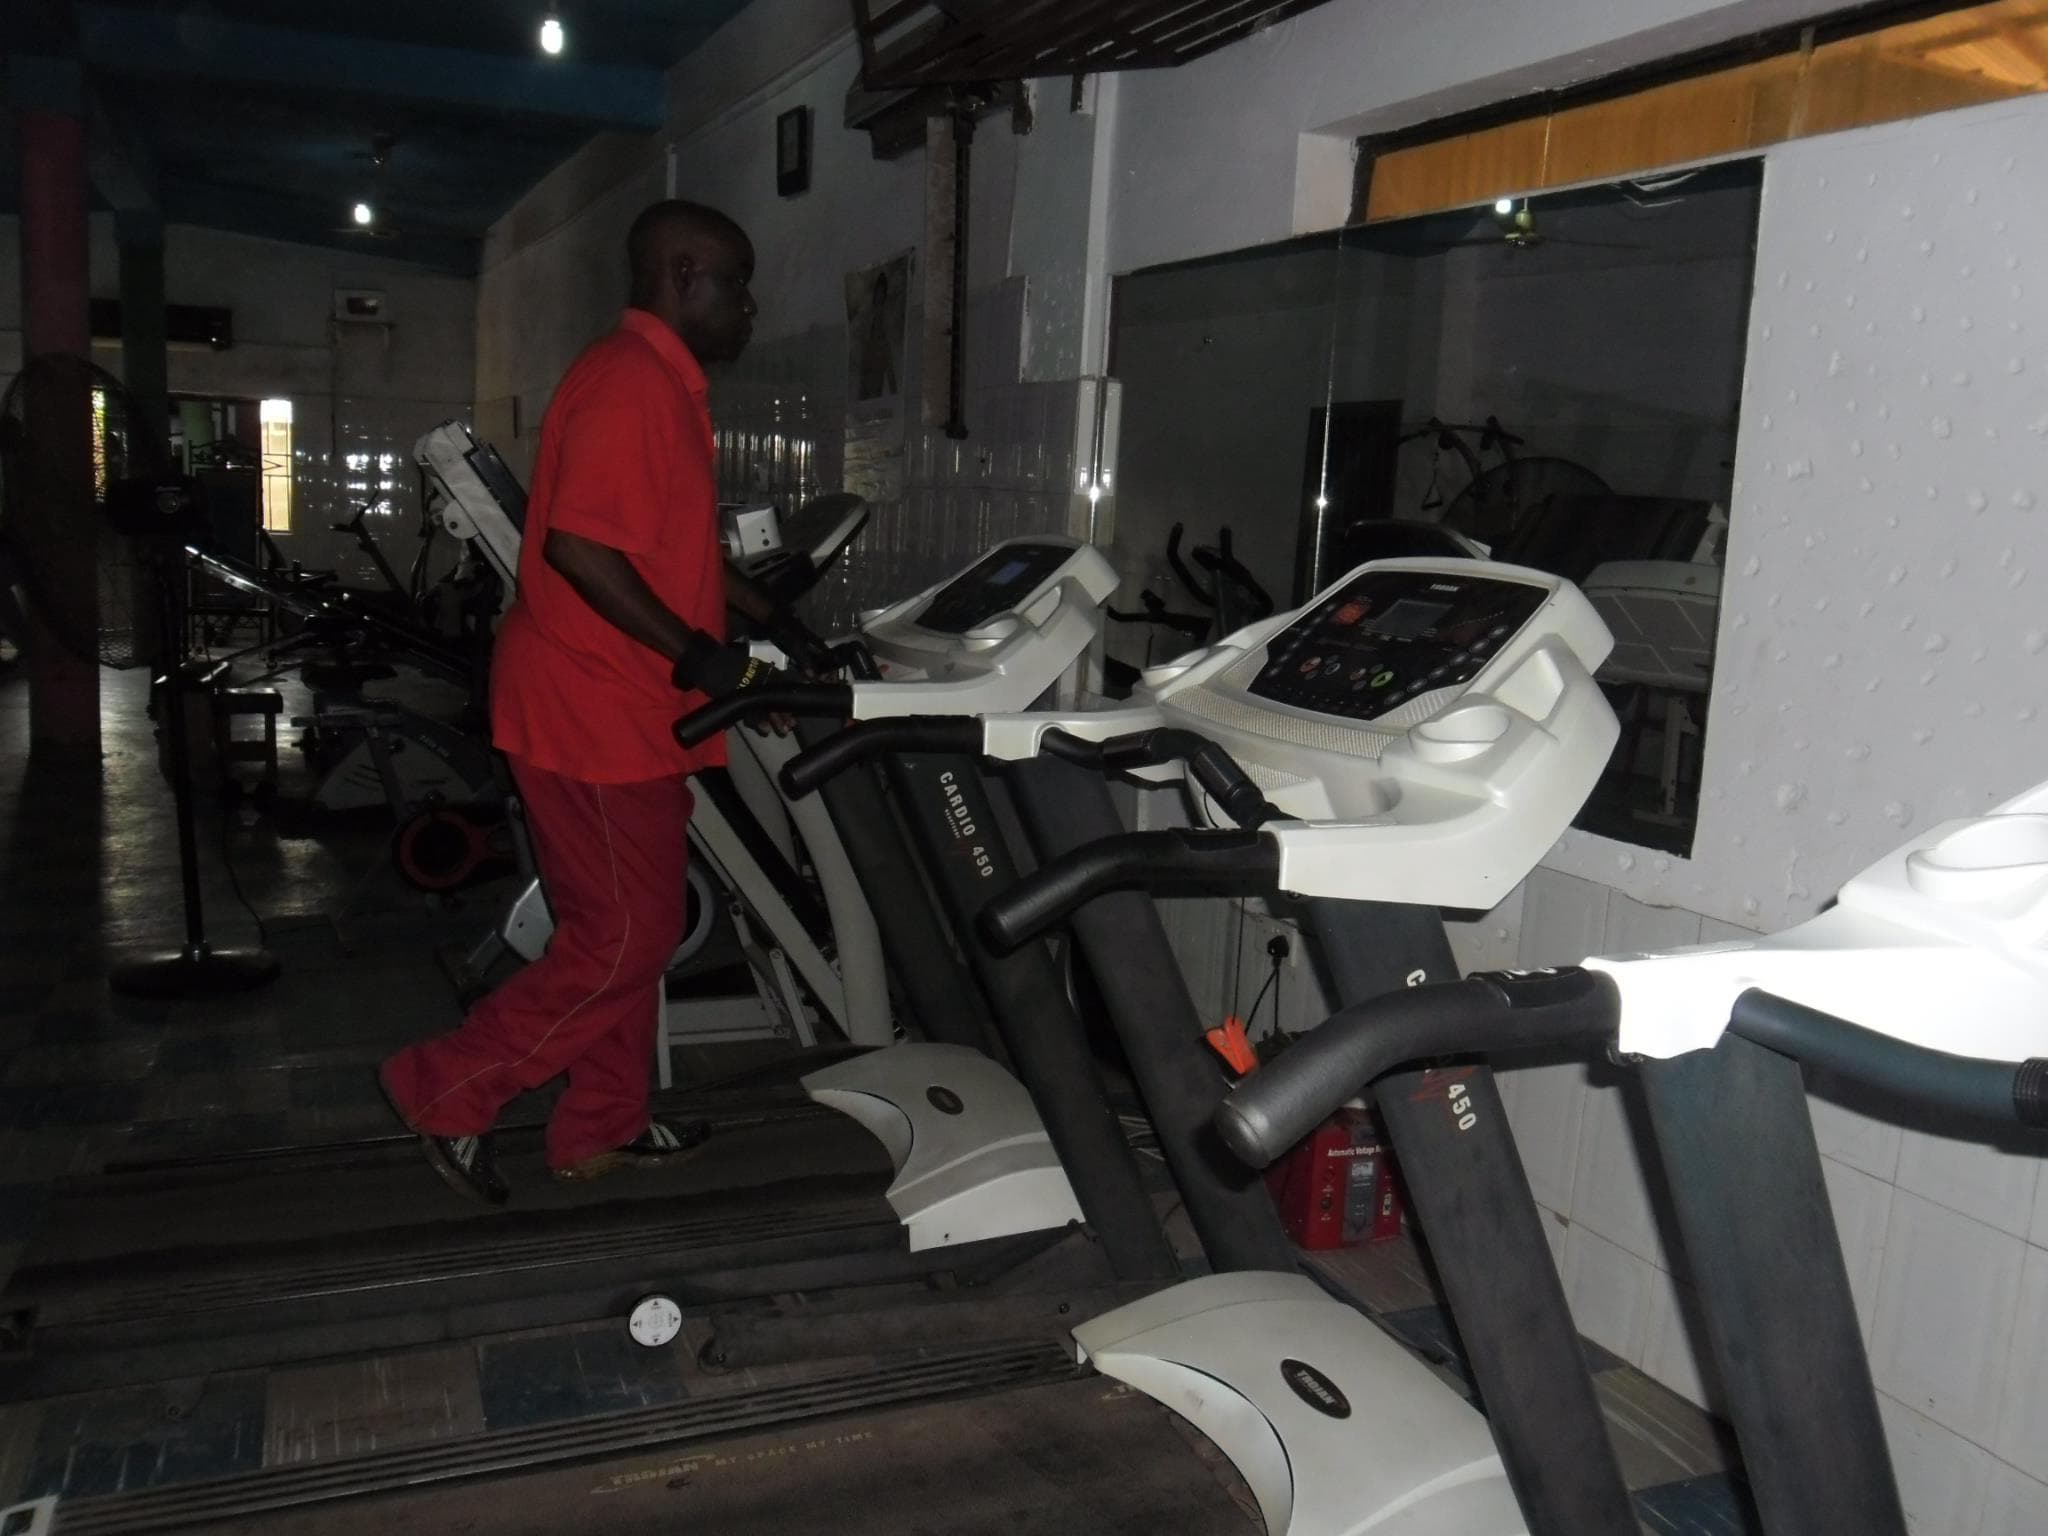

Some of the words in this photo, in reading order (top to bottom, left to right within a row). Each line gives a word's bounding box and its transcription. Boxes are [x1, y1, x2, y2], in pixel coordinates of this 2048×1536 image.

[940, 771, 976, 836] CARDIO
[973, 846, 993, 877] 450
[1448, 1083, 1477, 1131] 450
[1296, 1369, 1335, 1404] TROJAN
[836, 1431, 873, 1445] TIME
